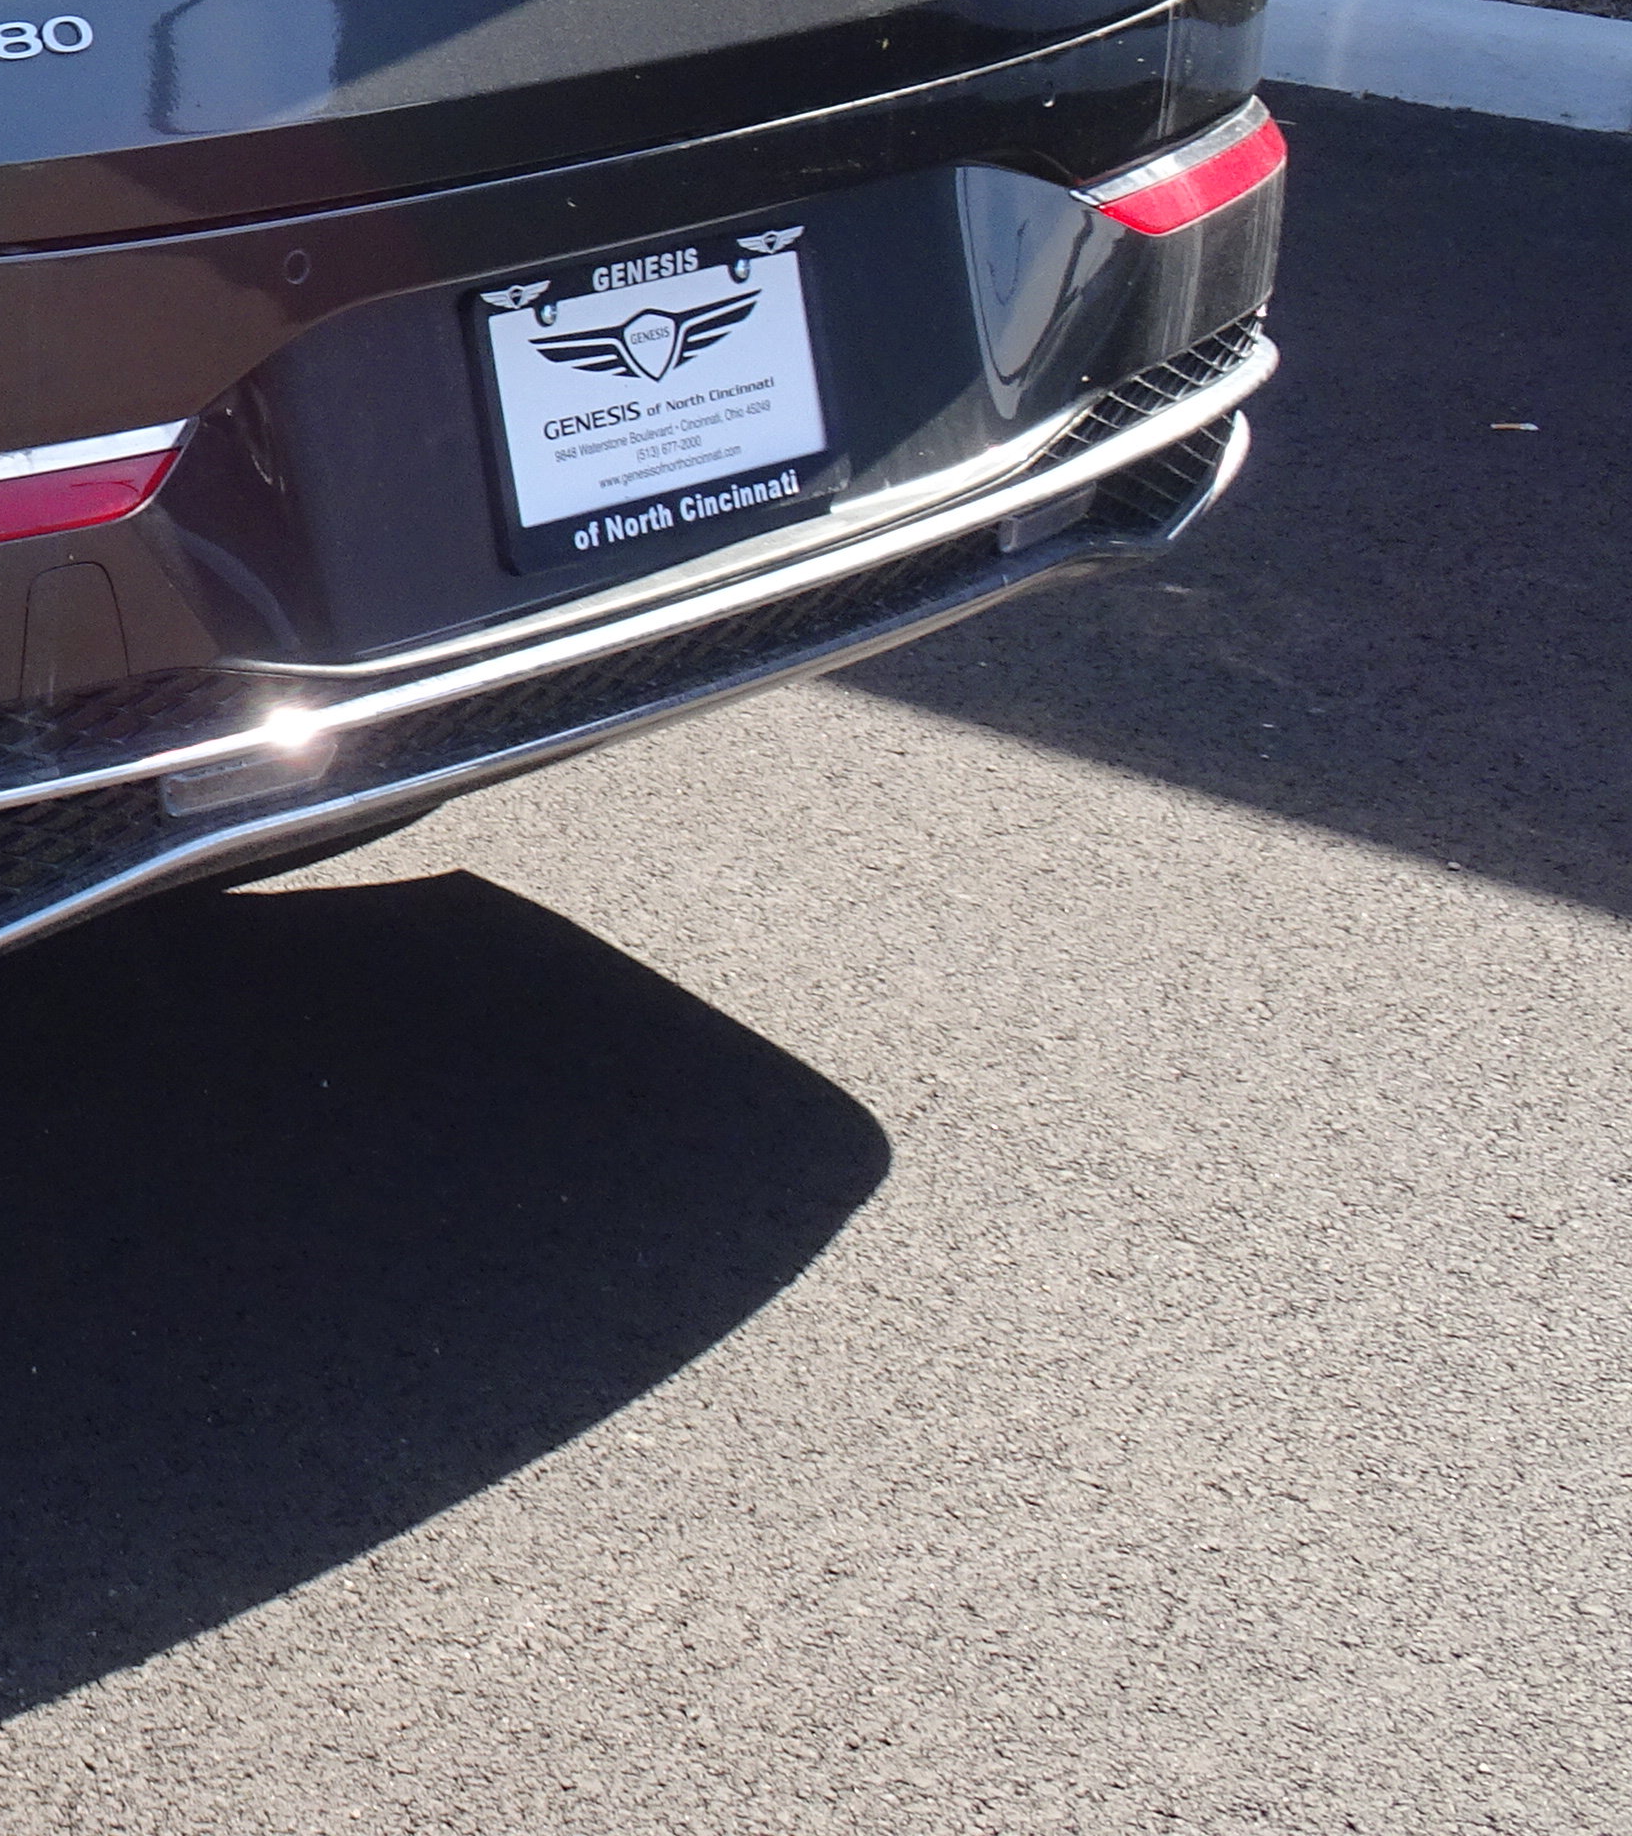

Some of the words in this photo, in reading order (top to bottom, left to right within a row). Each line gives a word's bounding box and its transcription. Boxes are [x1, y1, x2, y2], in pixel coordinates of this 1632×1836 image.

[592, 247, 699, 292] GENESIS
[630, 326, 670, 345] GENESIS
[543, 401, 642, 440] GENESIS
[646, 403, 662, 417] of
[665, 394, 706, 412] North
[708, 376, 775, 402] Cincinnati
[574, 521, 600, 550] of
[604, 503, 675, 543] North
[679, 468, 801, 522] Cincinnati
